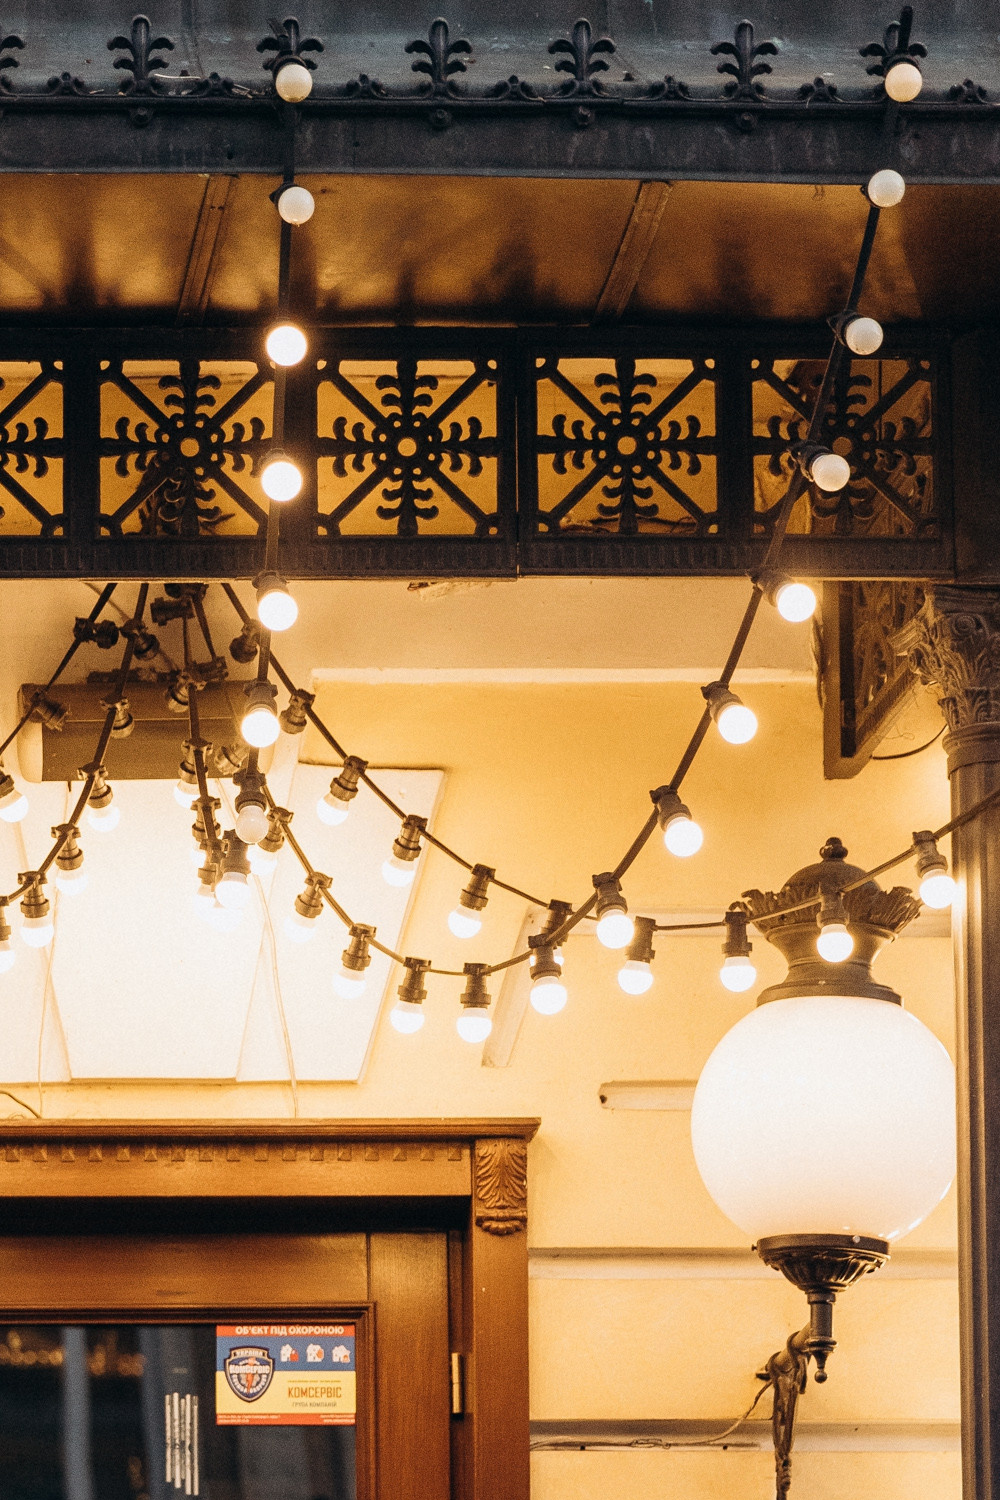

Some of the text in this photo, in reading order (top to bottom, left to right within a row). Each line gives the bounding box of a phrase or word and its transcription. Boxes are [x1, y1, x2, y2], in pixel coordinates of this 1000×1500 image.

[235, 1326, 344, 1336] ОБ'ЄКТ ПІД ОХОРОНОЮ
[230, 1364, 270, 1374] КОМСЕРВІС
[288, 1386, 342, 1398] КОМСЕРВІС
